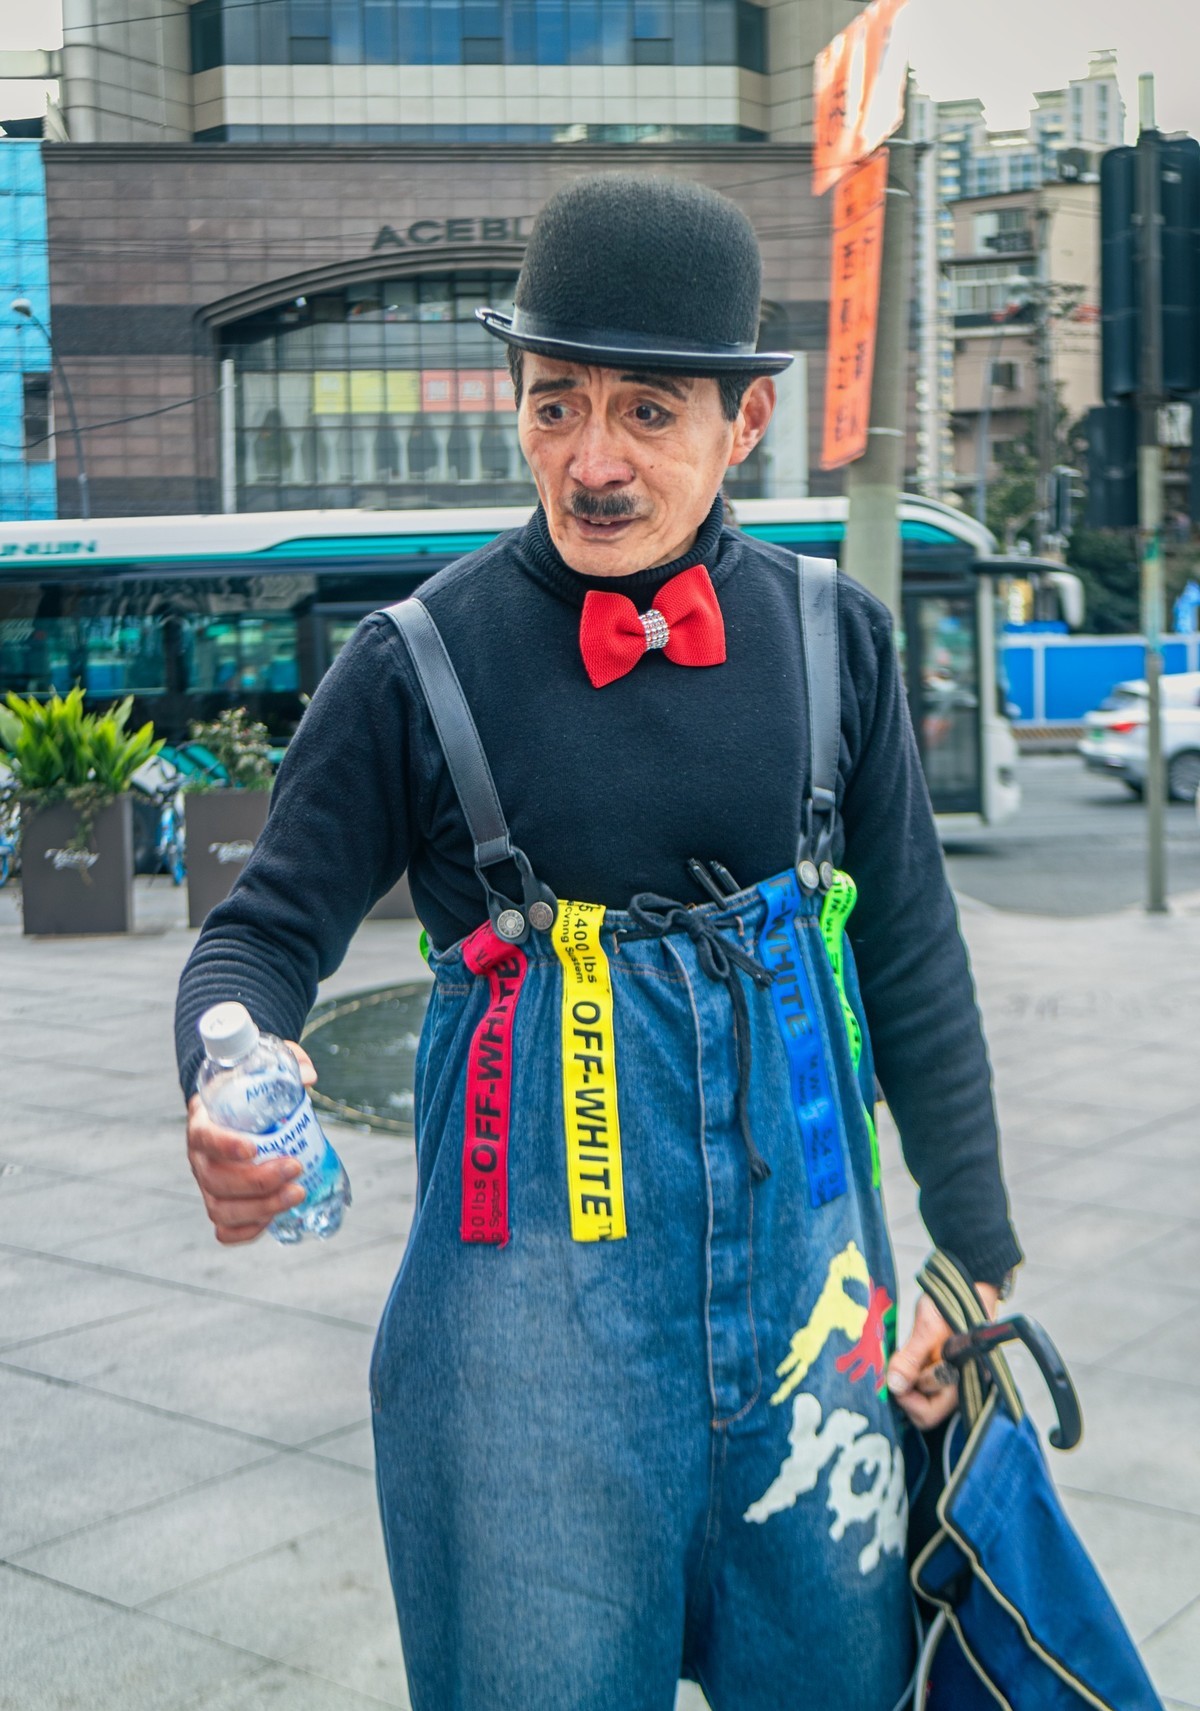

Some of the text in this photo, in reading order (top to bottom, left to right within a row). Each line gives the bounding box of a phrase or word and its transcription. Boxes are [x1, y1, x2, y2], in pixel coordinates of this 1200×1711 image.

[574, 904, 597, 983] 5,400 lbs
[470, 956, 521, 1174] OFF-WHITE
[572, 1001, 613, 1217] OFF-WHITE
[471, 1180, 486, 1210] lbs
